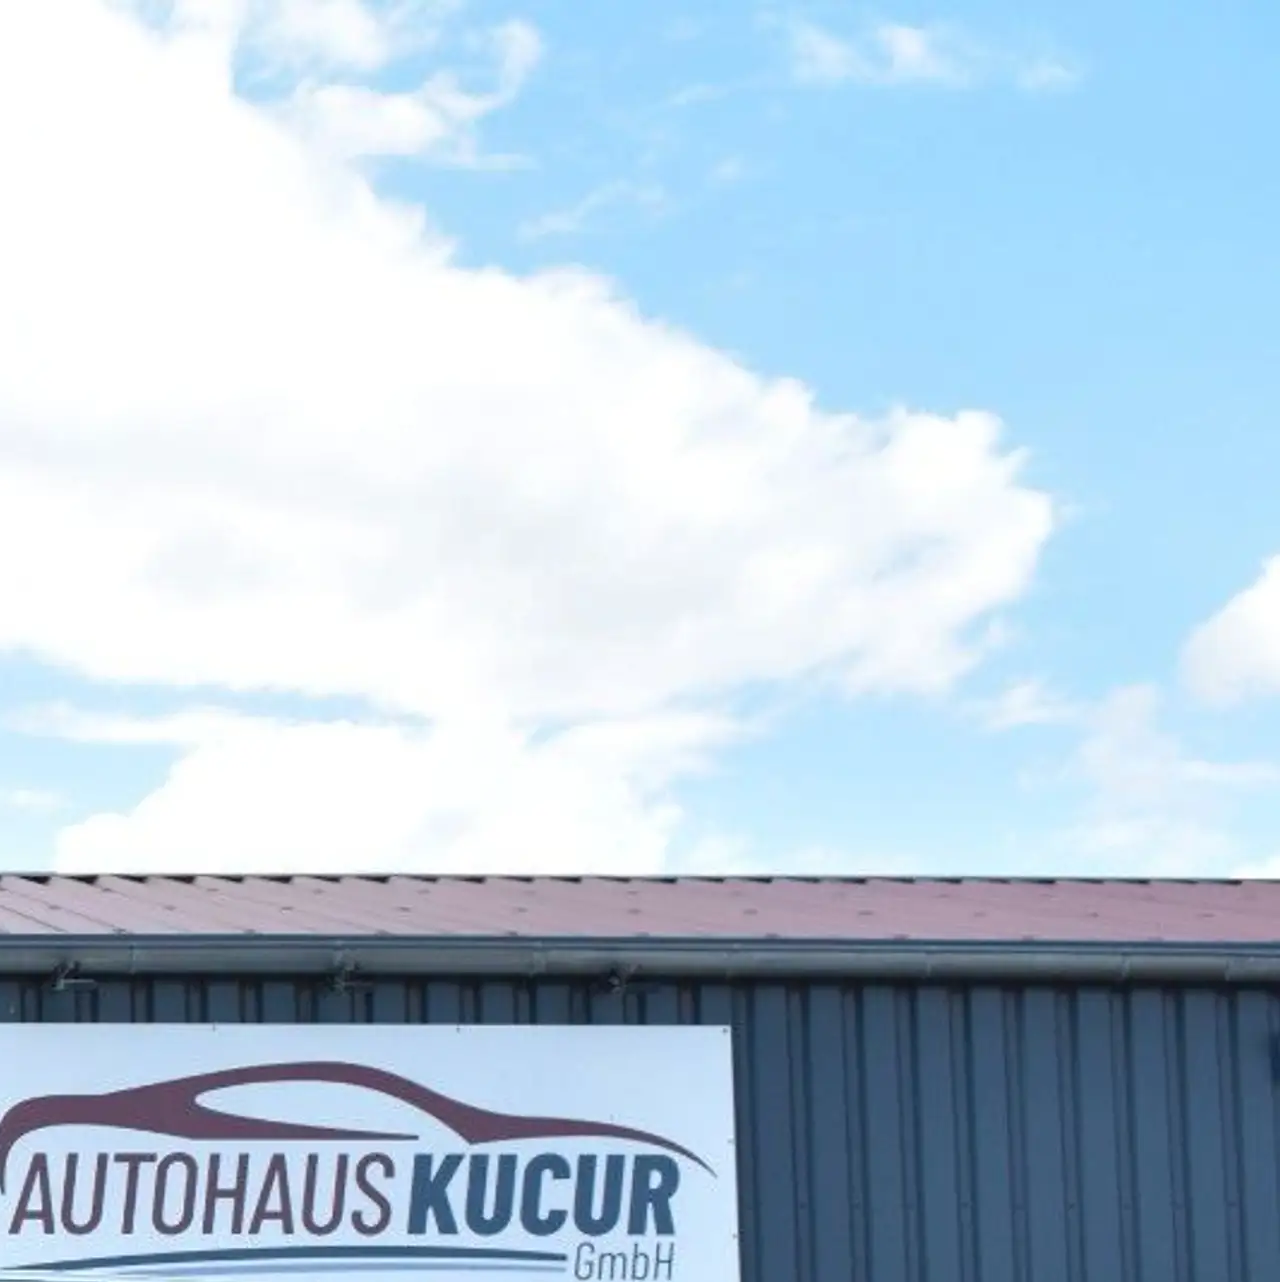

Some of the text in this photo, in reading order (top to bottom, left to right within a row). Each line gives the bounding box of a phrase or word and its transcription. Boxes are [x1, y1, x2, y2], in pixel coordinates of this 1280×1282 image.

[8, 1151, 681, 1236] AUTOHAUS KUCUR
[574, 1243, 675, 1281] GmbH
